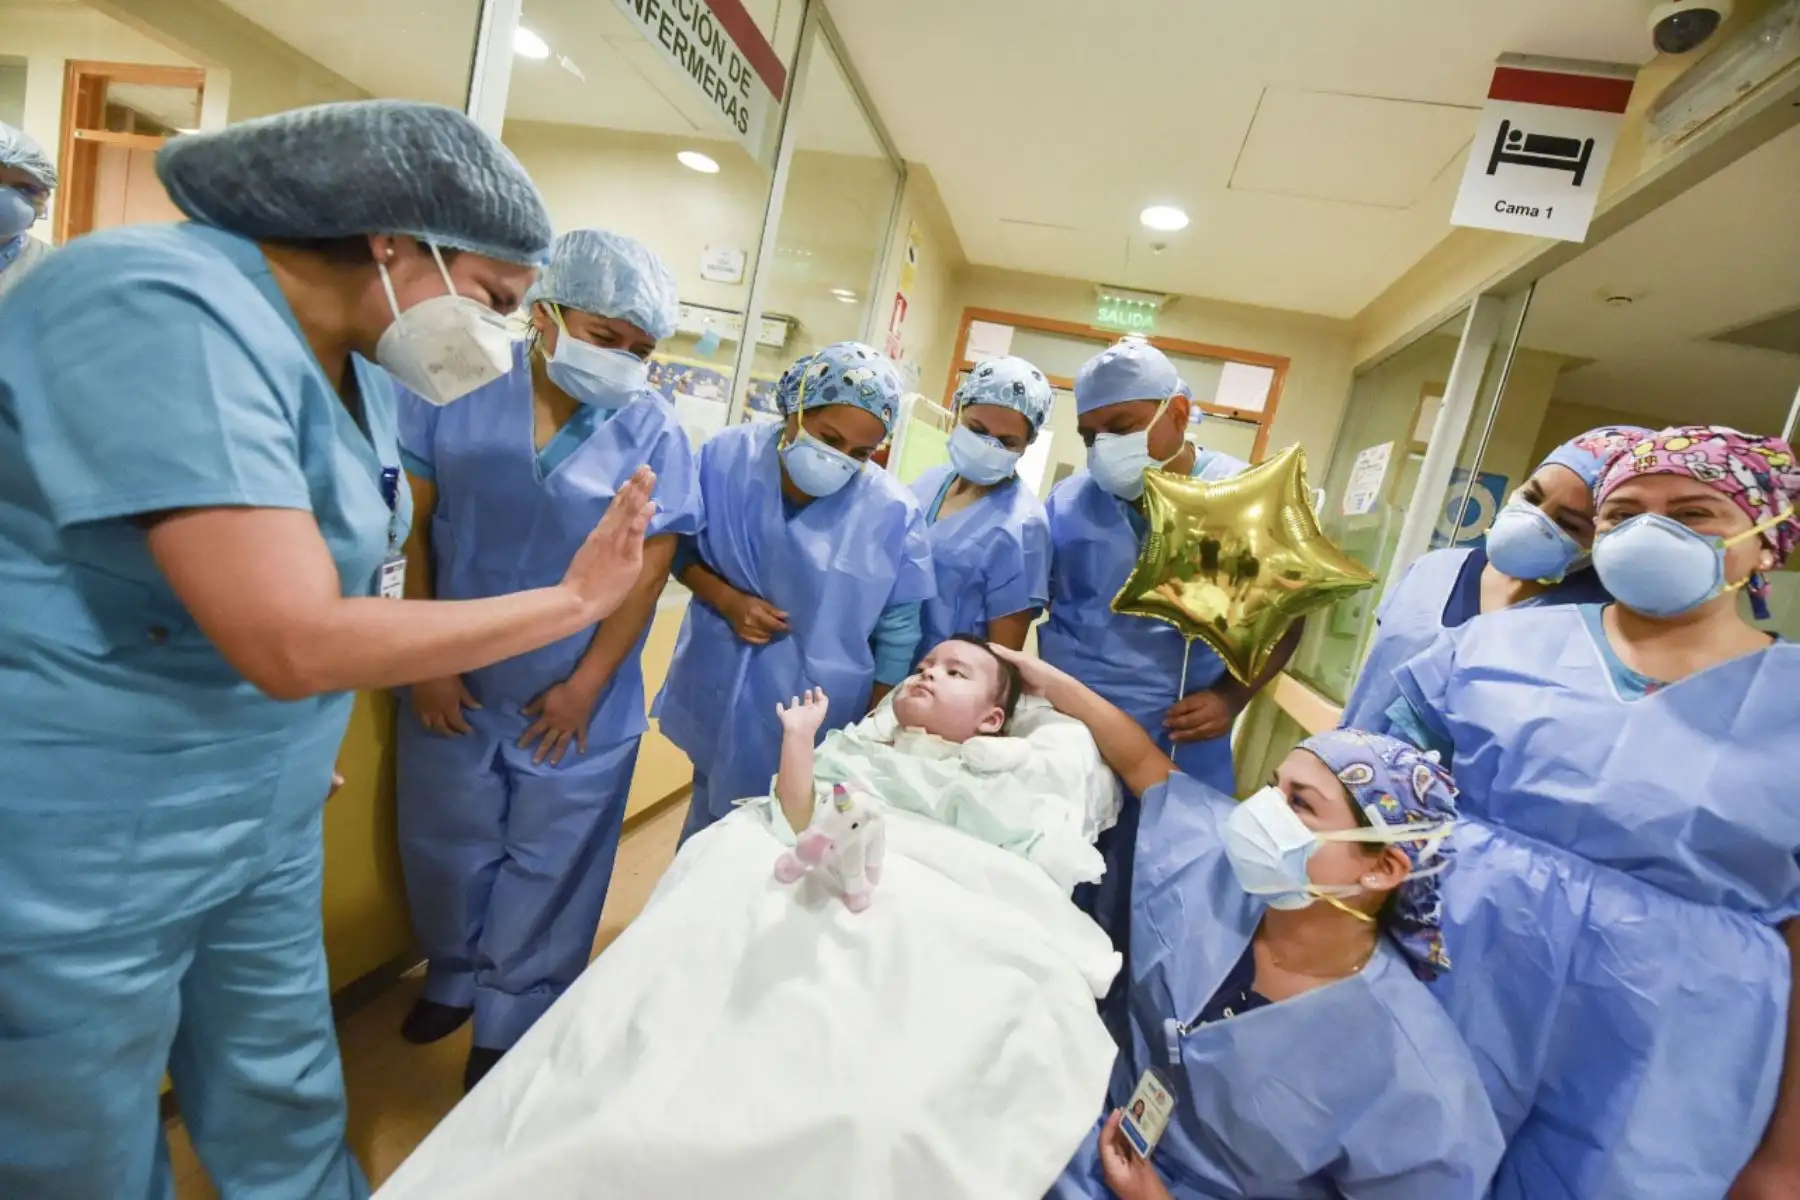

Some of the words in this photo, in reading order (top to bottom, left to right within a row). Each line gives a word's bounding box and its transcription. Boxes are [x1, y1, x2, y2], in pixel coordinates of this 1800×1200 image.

[672, 0, 726, 65] CIÓN
[728, 52, 752, 98] DE
[1494, 200, 1540, 218] Cama
[1545, 206, 1554, 219] 1
[1097, 308, 1154, 329] SALIDA
